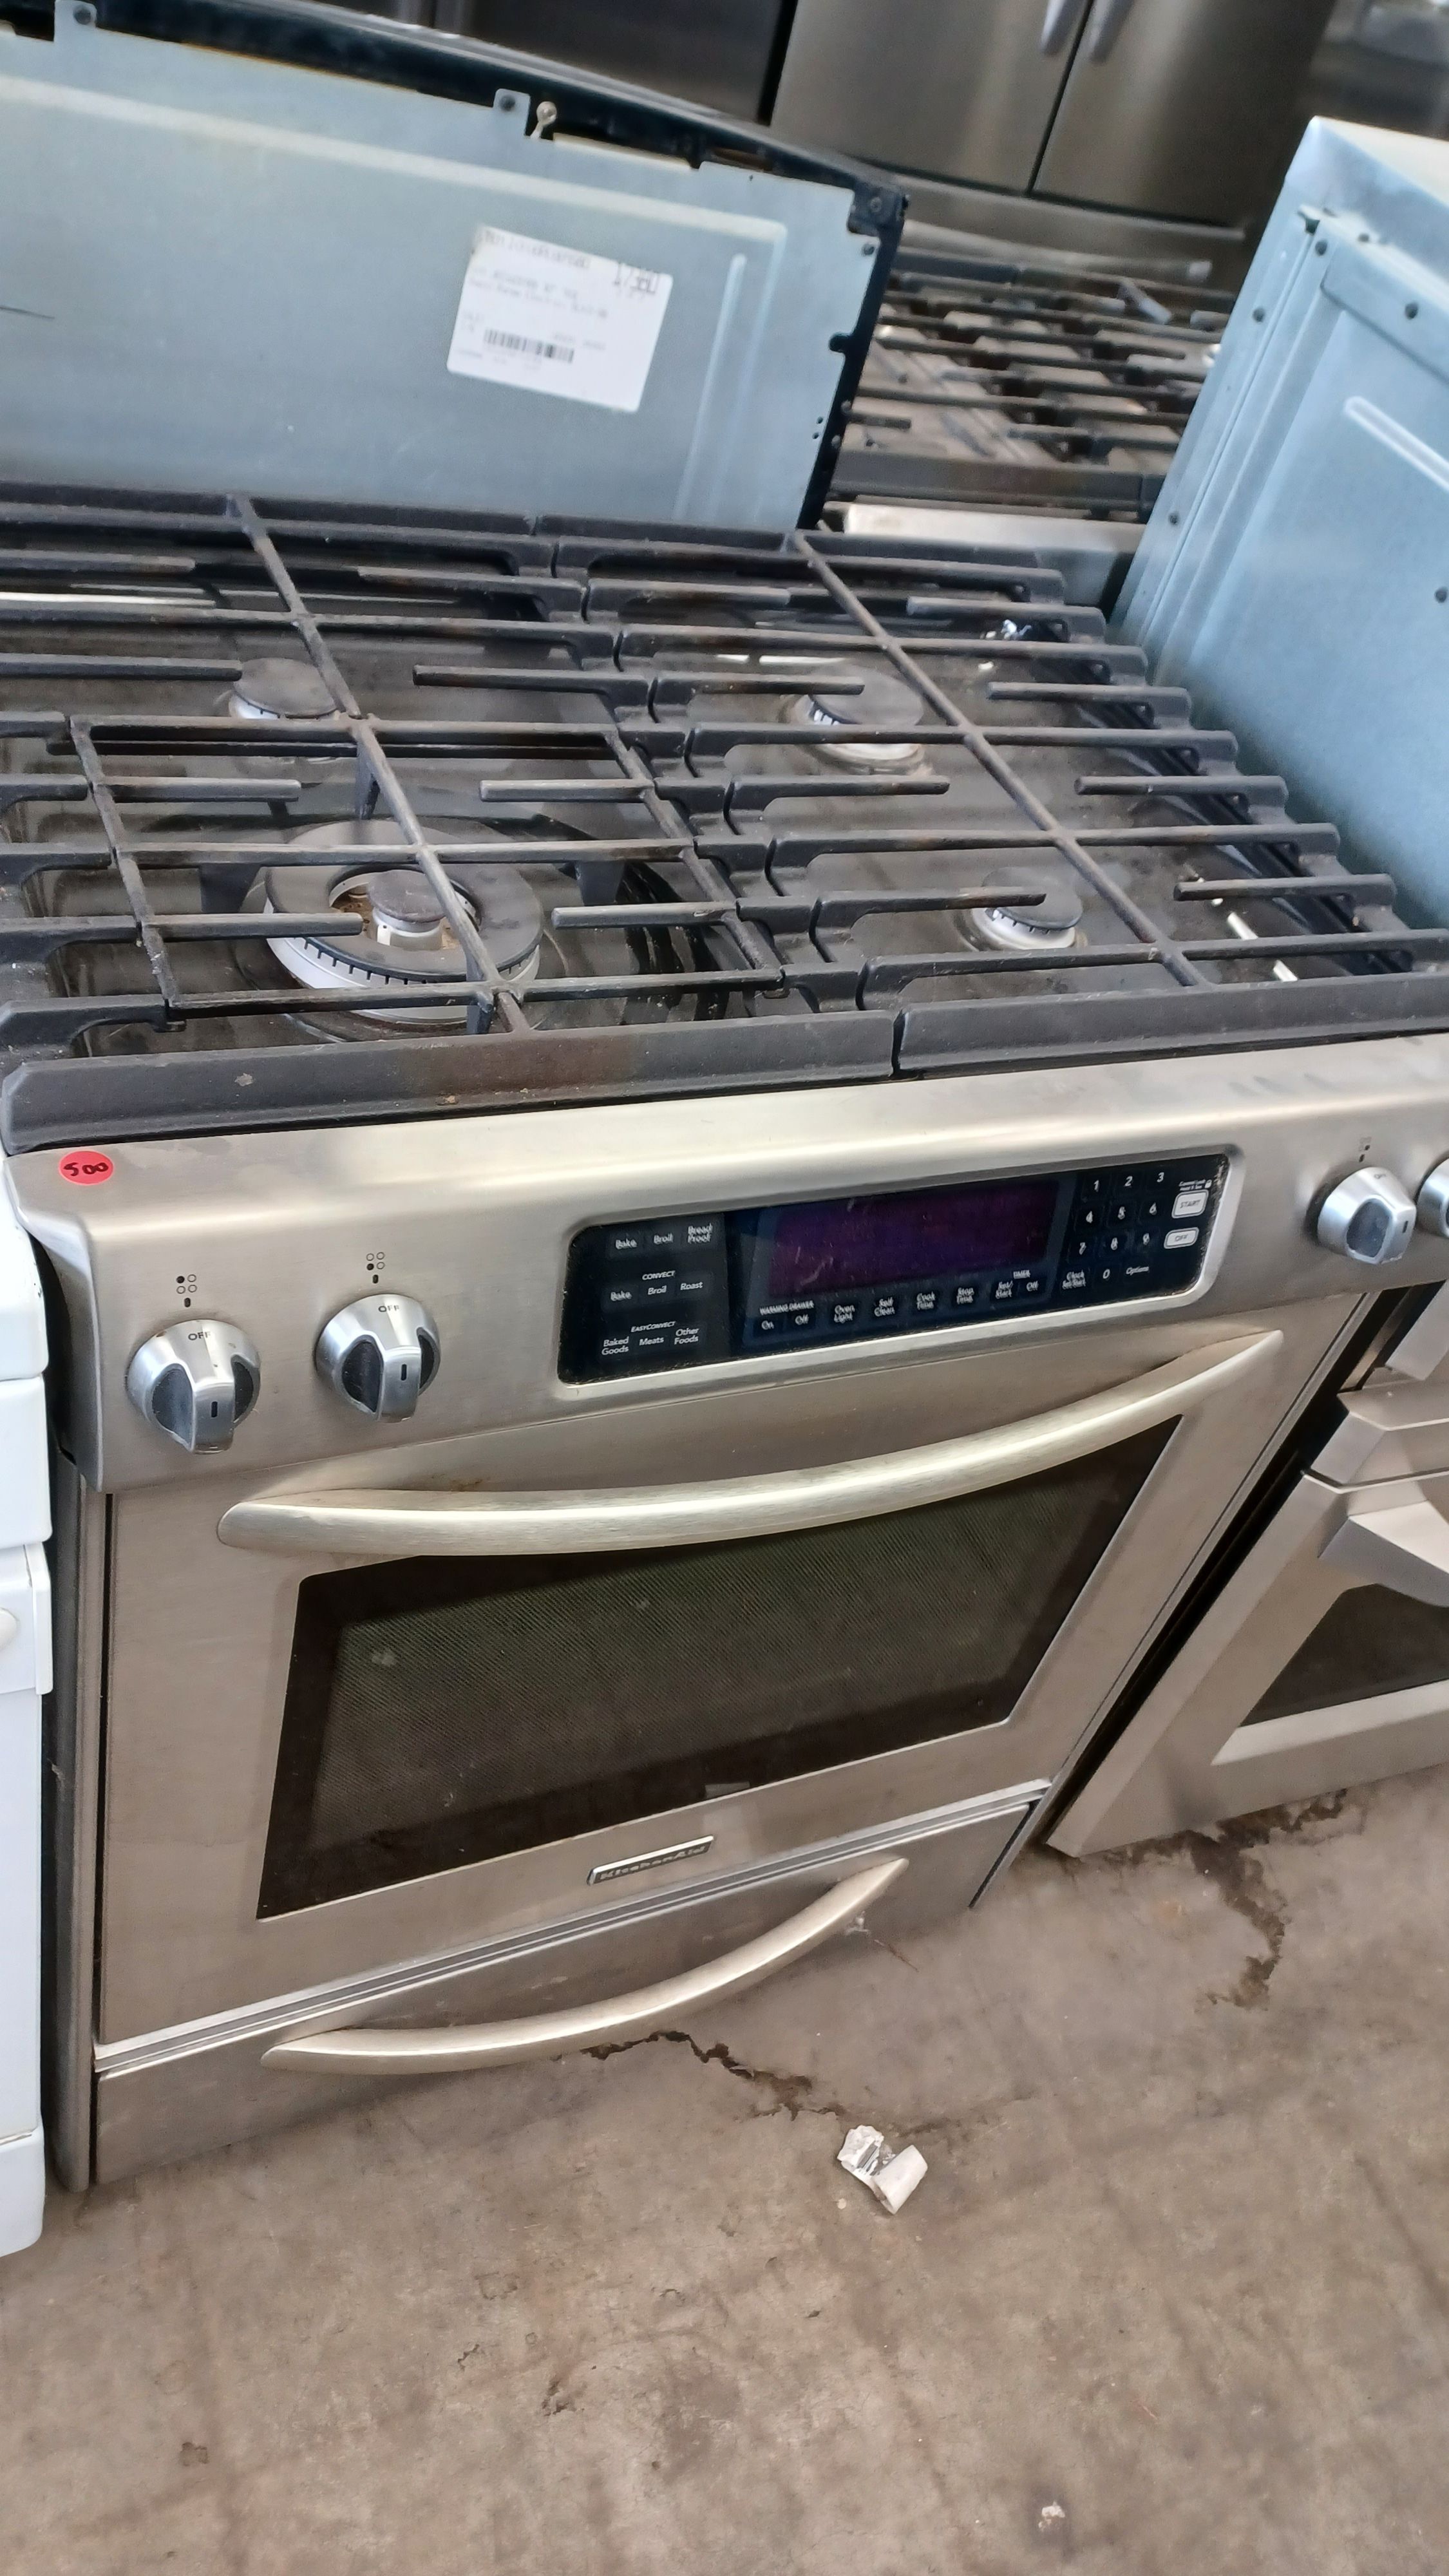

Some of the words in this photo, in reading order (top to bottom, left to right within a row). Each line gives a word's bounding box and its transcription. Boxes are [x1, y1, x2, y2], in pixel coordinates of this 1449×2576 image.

[63, 1162, 109, 1177] 500
[1094, 1180, 1100, 1191] 1
[1124, 1176, 1133, 1188] 2
[1157, 1172, 1165, 1183] 3
[1149, 1202, 1158, 1215] 6
[615, 1238, 637, 1250] Bake
[653, 1233, 674, 1245] Broil
[641, 1270, 676, 1281] CONVECT
[610, 1291, 632, 1302] Bake
[647, 1285, 667, 1295] Broil
[679, 1281, 703, 1291] Roast
[378, 1304, 400, 1312] OFF
[630, 1320, 676, 1334] EASYCONVECT
[761, 1320, 774, 1331] On
[795, 1314, 810, 1325] Off
[188, 1331, 211, 1341] OFF
[676, 1326, 699, 1338] Other
[603, 1336, 629, 1348] Baked
[639, 1336, 664, 1347] Meats
[674, 1334, 699, 1345] Foods
[601, 1345, 629, 1356] Goods
